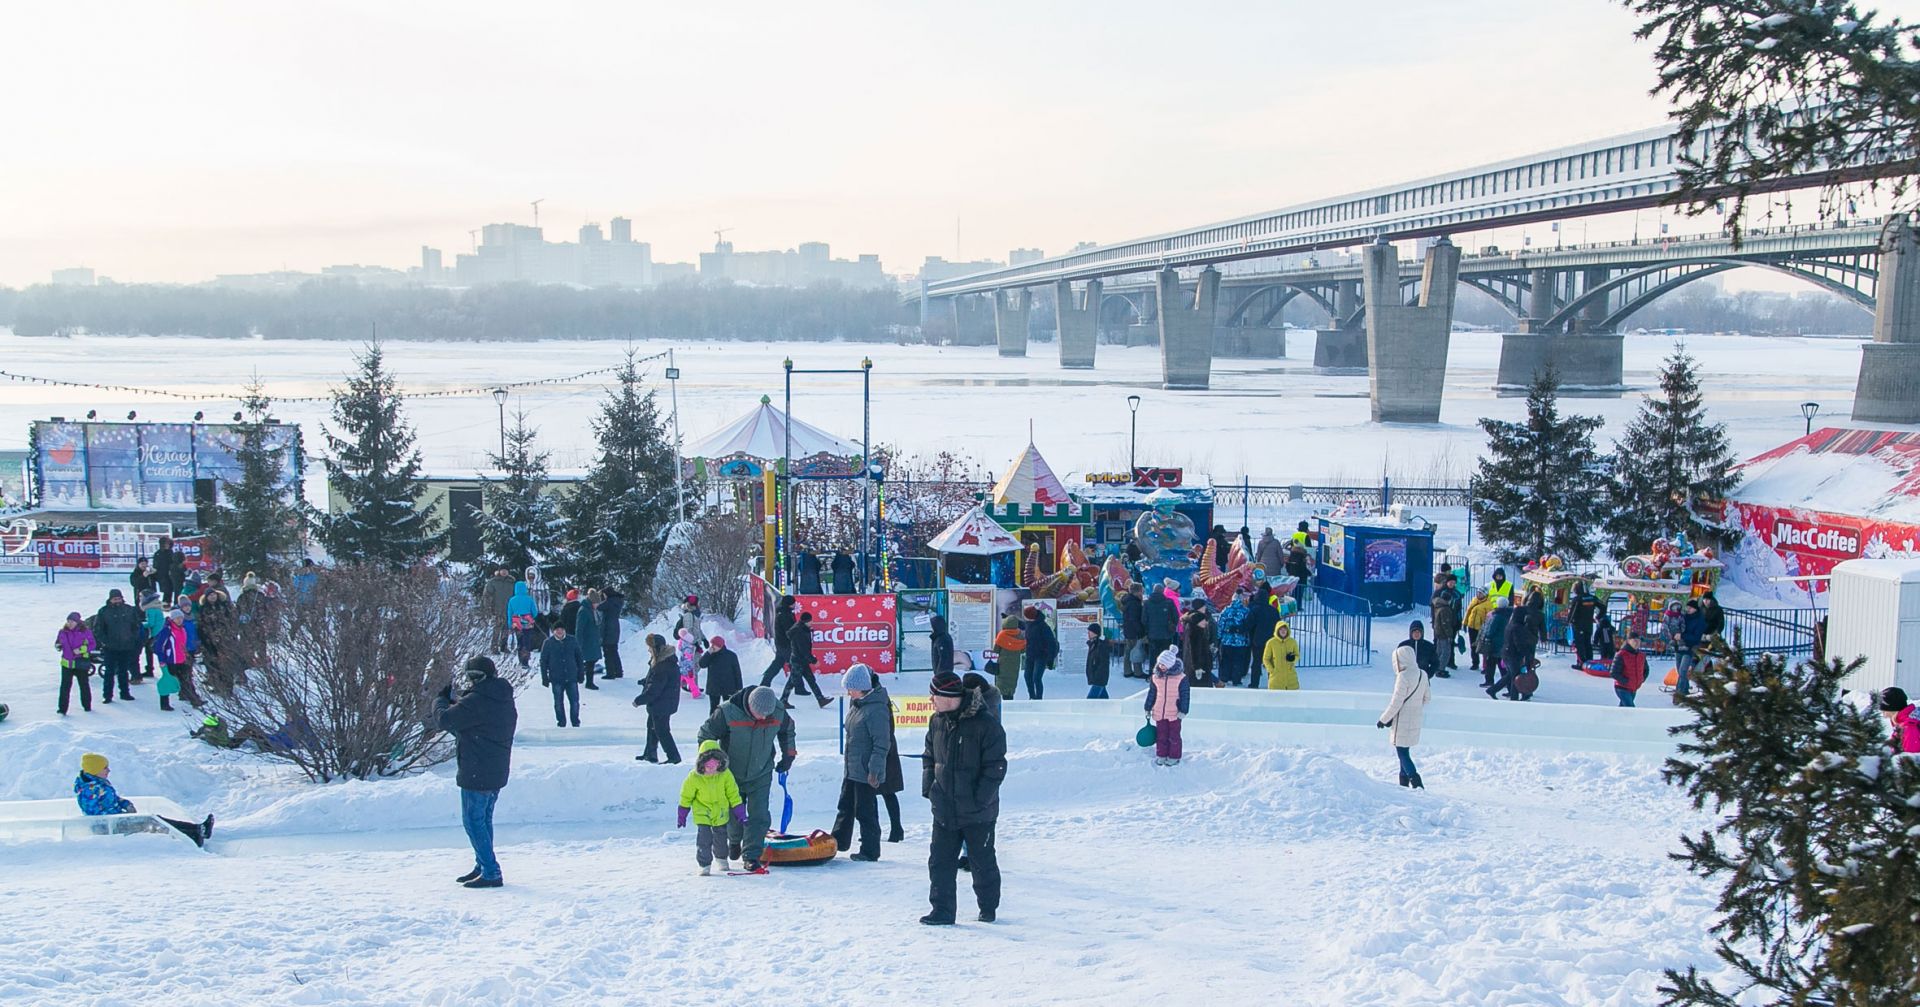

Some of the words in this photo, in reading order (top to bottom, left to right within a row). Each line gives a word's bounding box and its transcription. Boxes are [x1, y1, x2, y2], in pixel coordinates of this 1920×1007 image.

[136, 443, 199, 465] Желаем
[1086, 472, 1132, 483] КИНО
[1777, 522, 1858, 553] MacCoffee
[811, 627, 889, 644] acCoffee
[896, 715, 928, 724] ГОРКАМ
